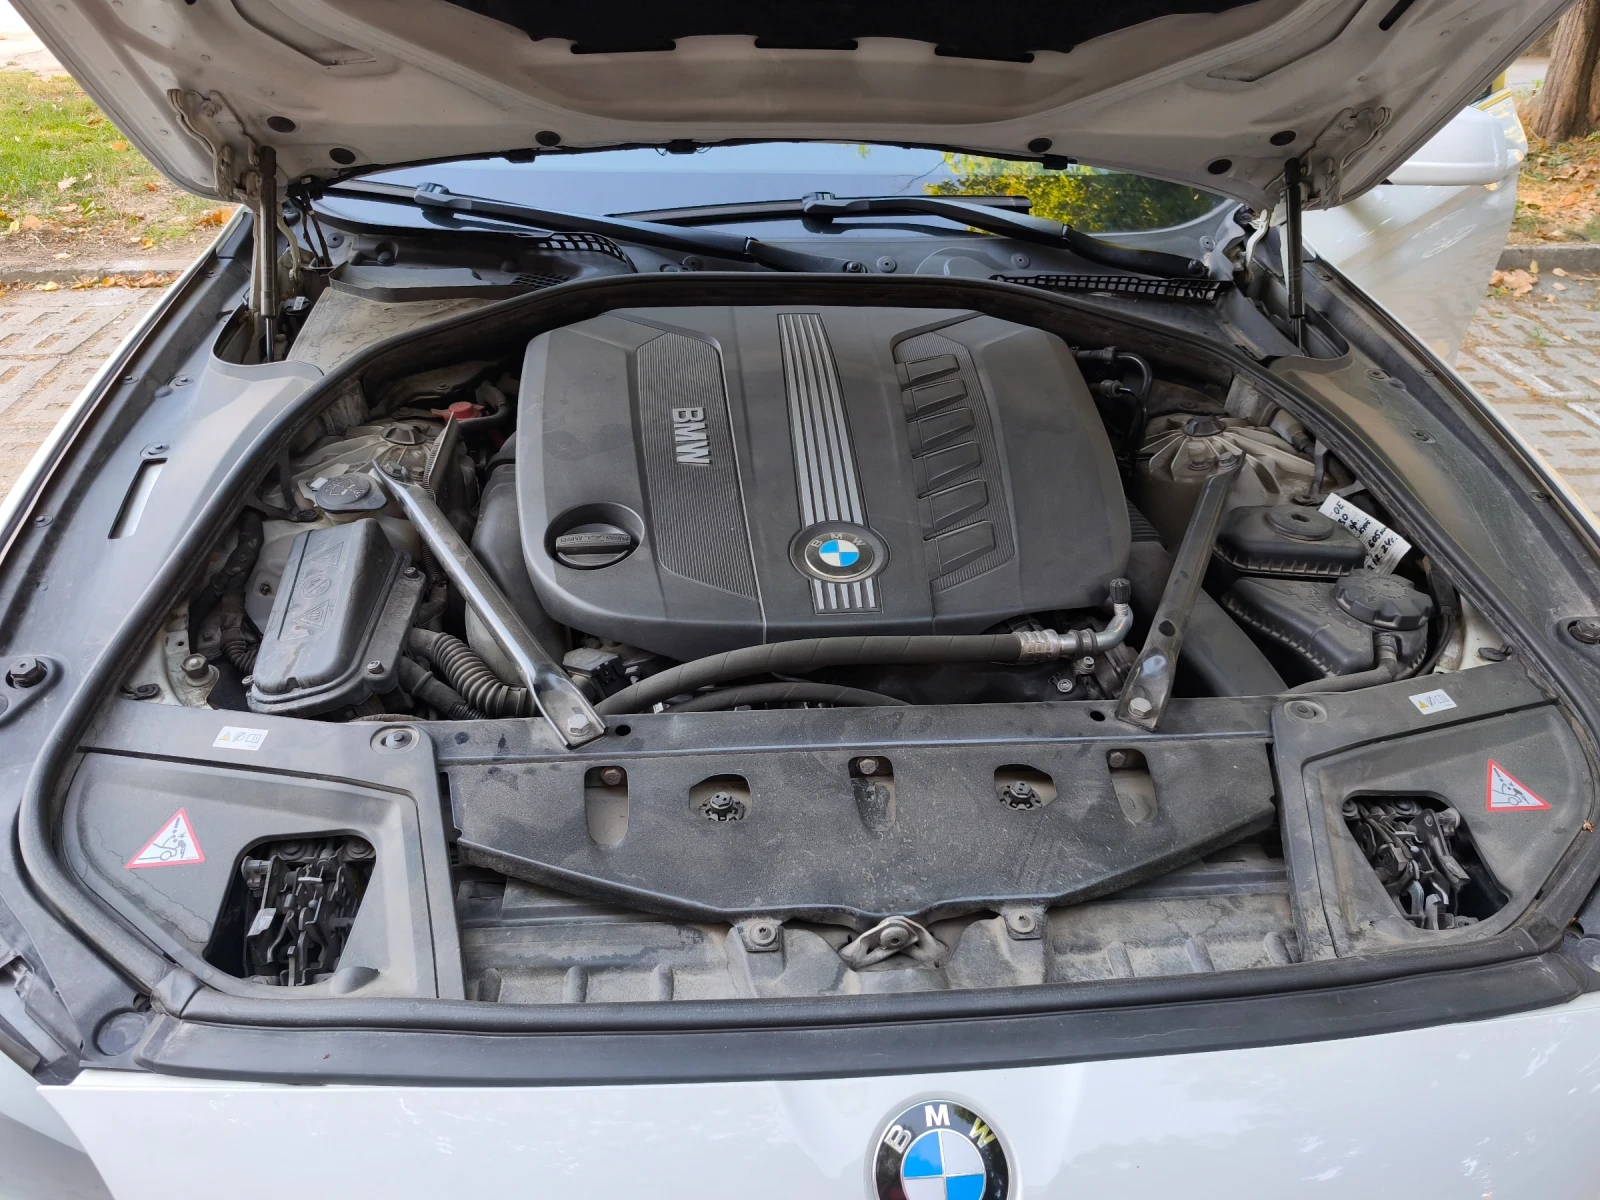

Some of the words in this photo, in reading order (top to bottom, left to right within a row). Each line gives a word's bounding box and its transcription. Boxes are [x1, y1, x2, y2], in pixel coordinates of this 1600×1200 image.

[673, 407, 711, 464] BMW
[811, 533, 866, 548] BMW
[884, 1104, 996, 1154] BMW
